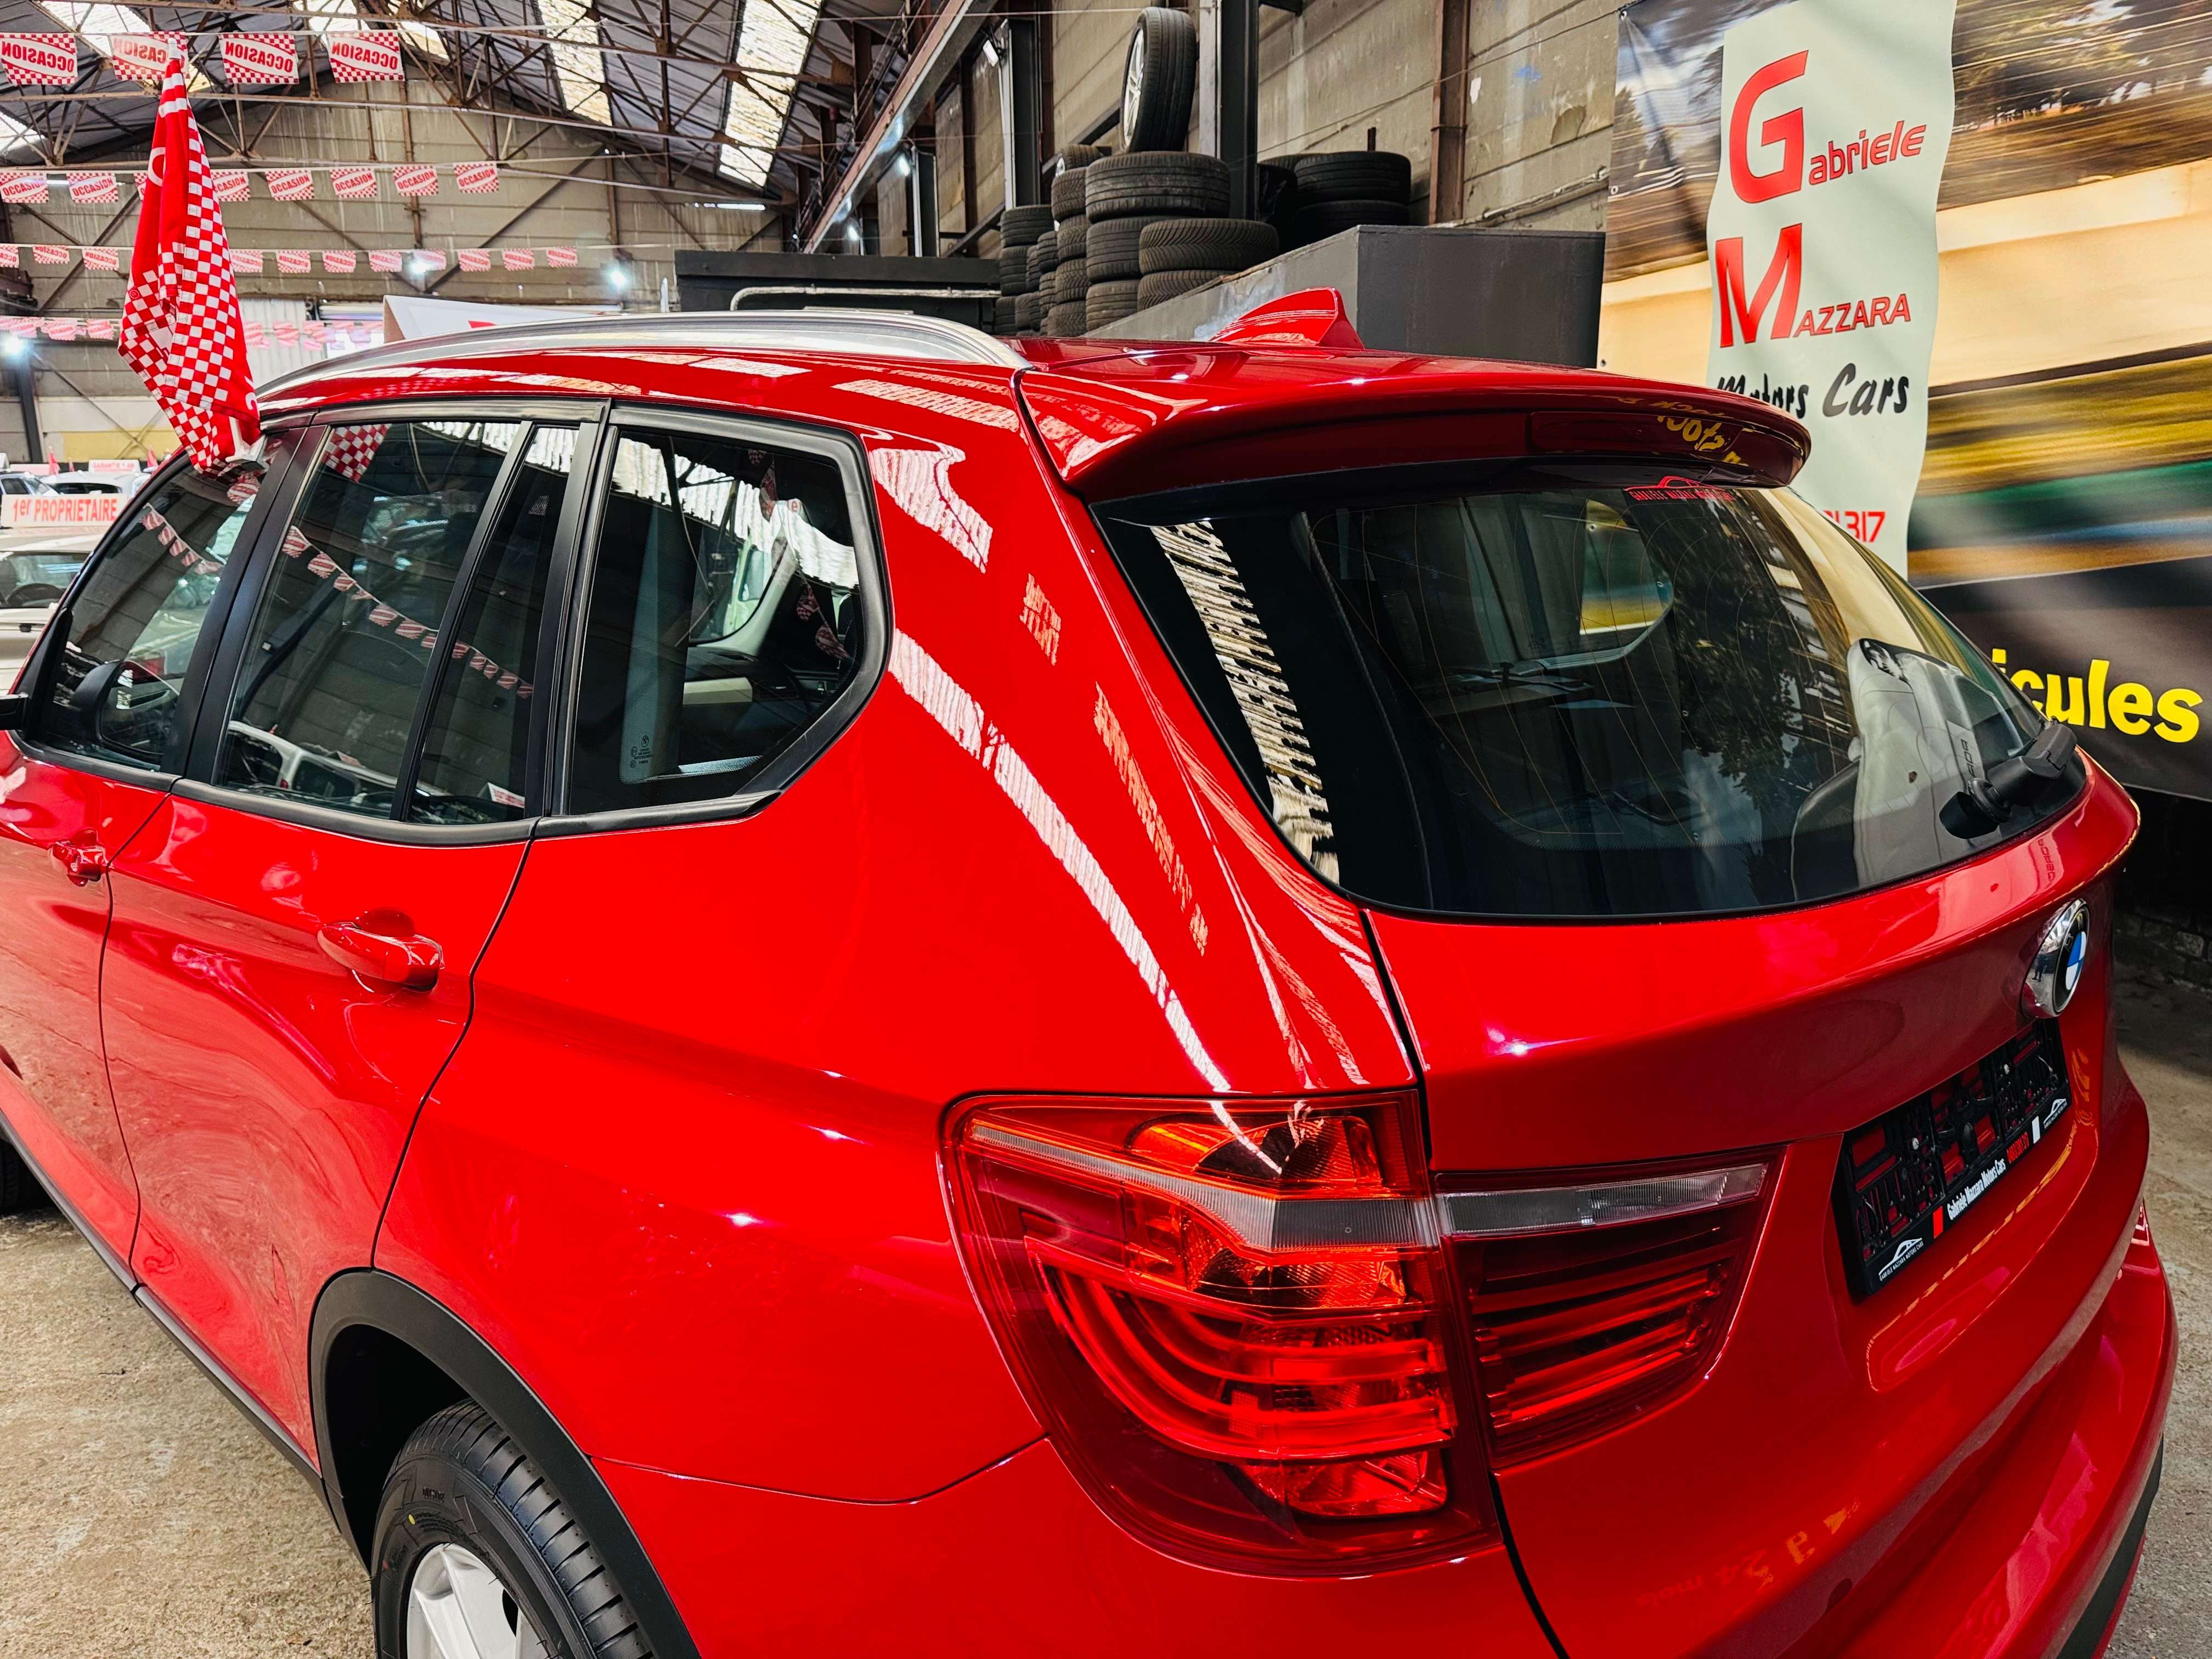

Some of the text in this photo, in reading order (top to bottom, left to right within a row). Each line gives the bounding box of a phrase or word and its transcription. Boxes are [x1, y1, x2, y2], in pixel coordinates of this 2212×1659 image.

[1729, 49, 1926, 204] Gabriele
[72, 178, 114, 196] OCCASION
[214, 176, 246, 193] CASION
[271, 175, 309, 194] OCCASION
[335, 172, 373, 191] OCCASION
[397, 170, 436, 189] OCCASION
[459, 168, 495, 187] OCCASION
[1716, 223, 1911, 347] MAZZARA
[1822, 363, 1909, 417] Cars
[13, 499, 117, 522] 1er PROPRIETAIRE
